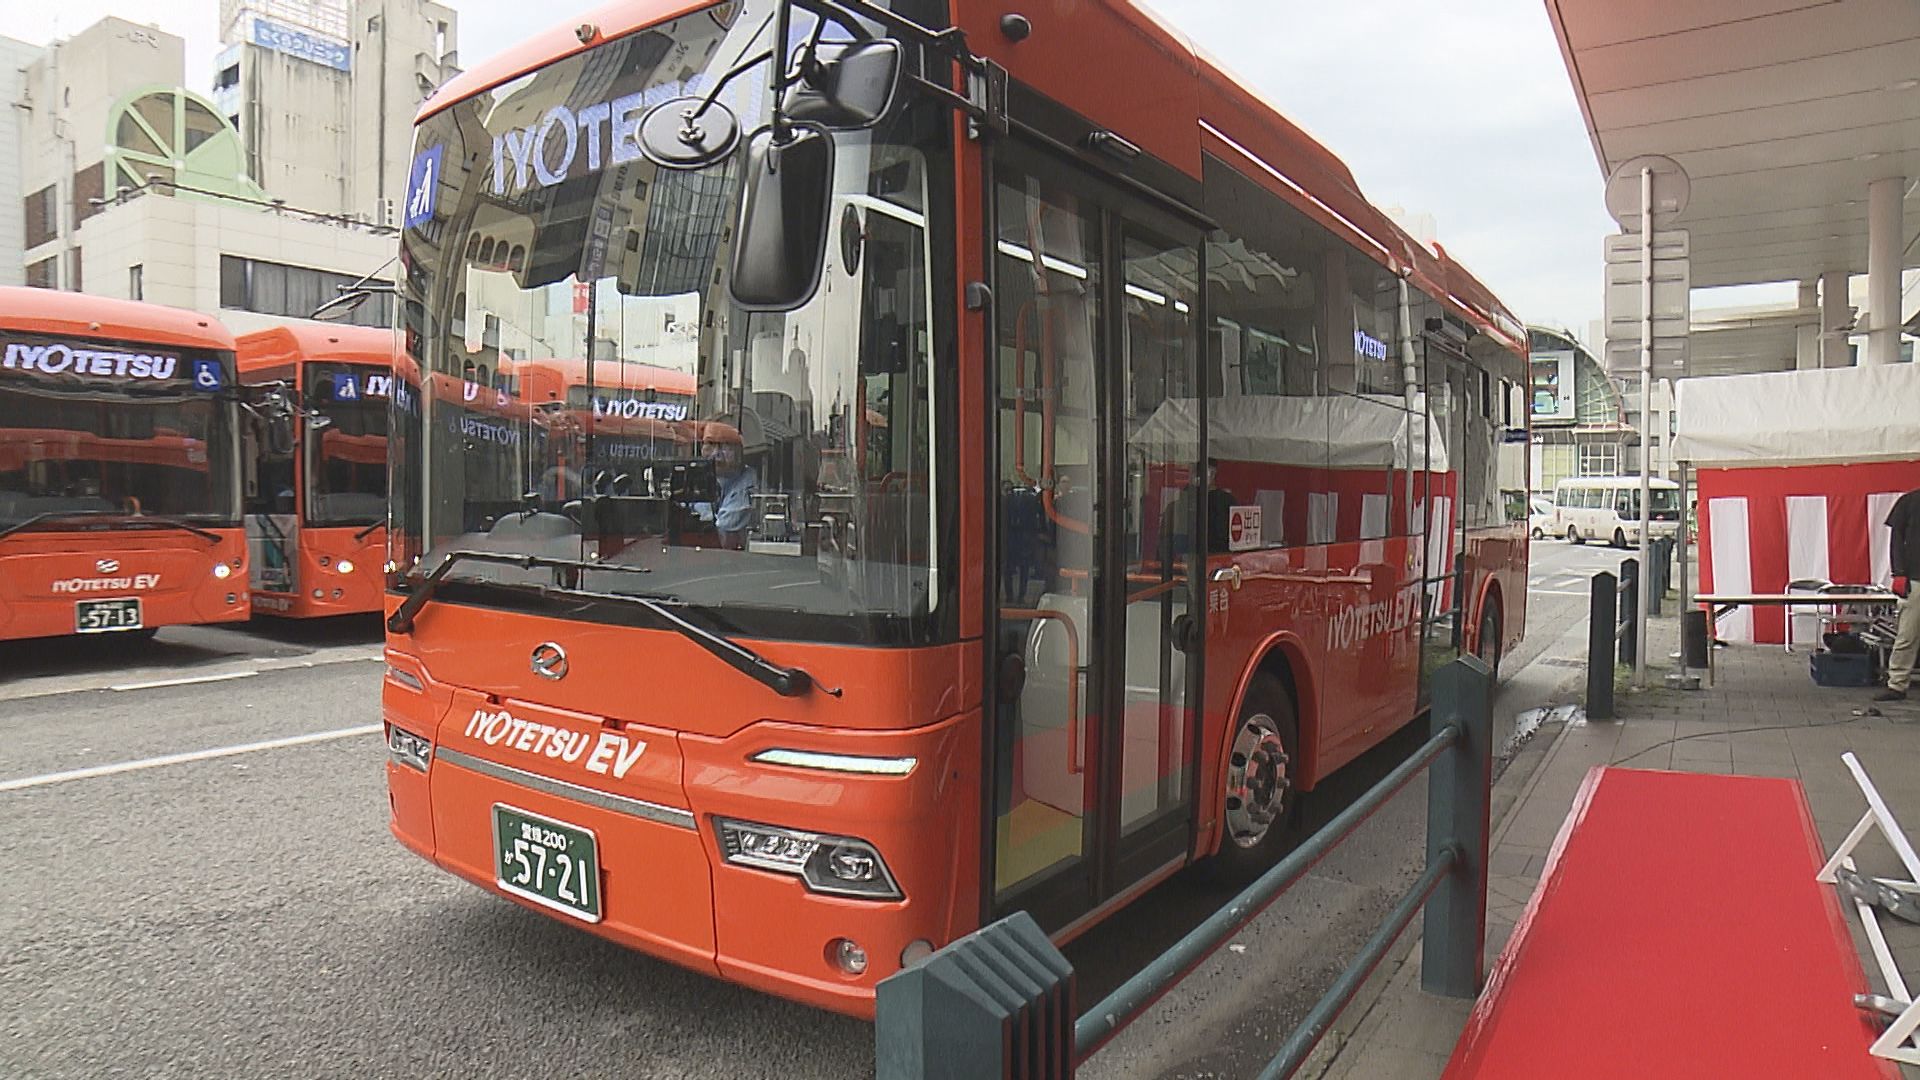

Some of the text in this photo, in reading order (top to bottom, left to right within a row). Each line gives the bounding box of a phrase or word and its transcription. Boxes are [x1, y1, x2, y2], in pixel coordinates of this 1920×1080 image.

[3, 343, 177, 380] IYOTETSU
[606, 398, 687, 421] IYOTETSU
[1244, 511, 1260, 529] 出口
[51, 574, 160, 593] IYOTETSU EV
[1327, 598, 1392, 652] IYOTETSU
[464, 710, 647, 779] IYOTETSU EV
